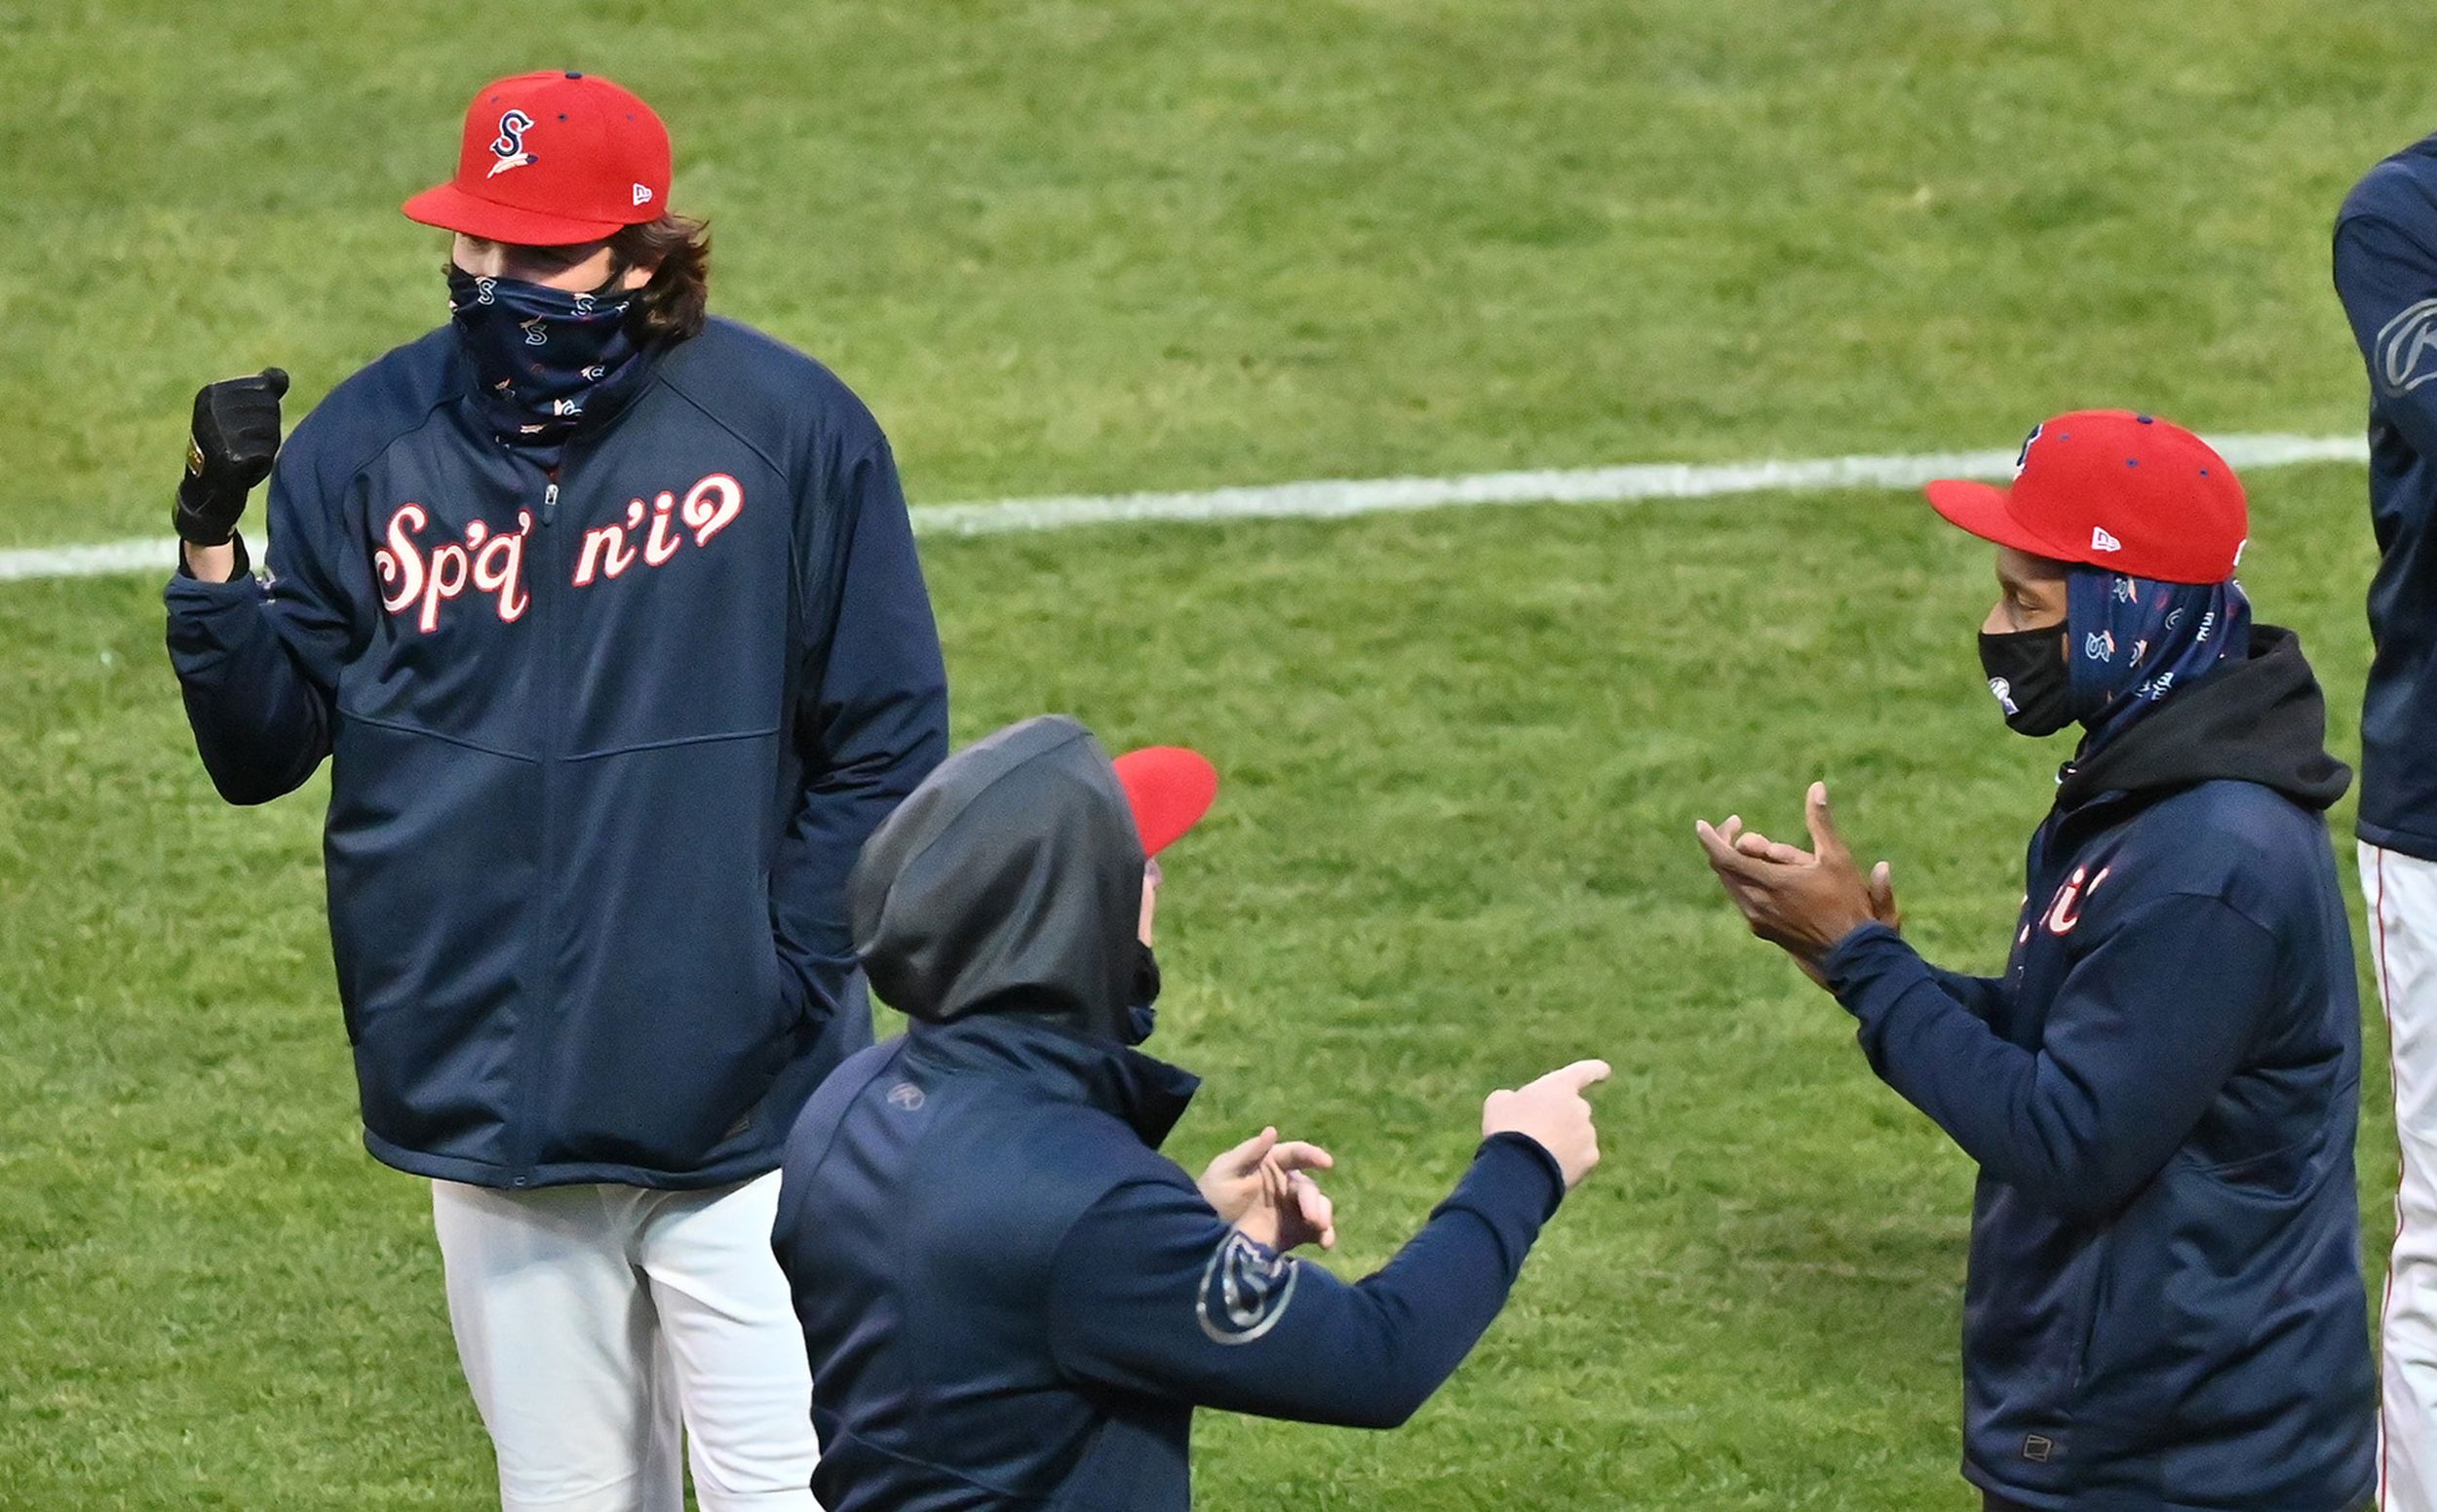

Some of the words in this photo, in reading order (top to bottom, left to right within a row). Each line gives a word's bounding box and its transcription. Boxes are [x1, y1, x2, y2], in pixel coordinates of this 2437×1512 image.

[489, 108, 535, 160] S
[477, 278, 498, 305] S
[524, 324, 548, 346] S
